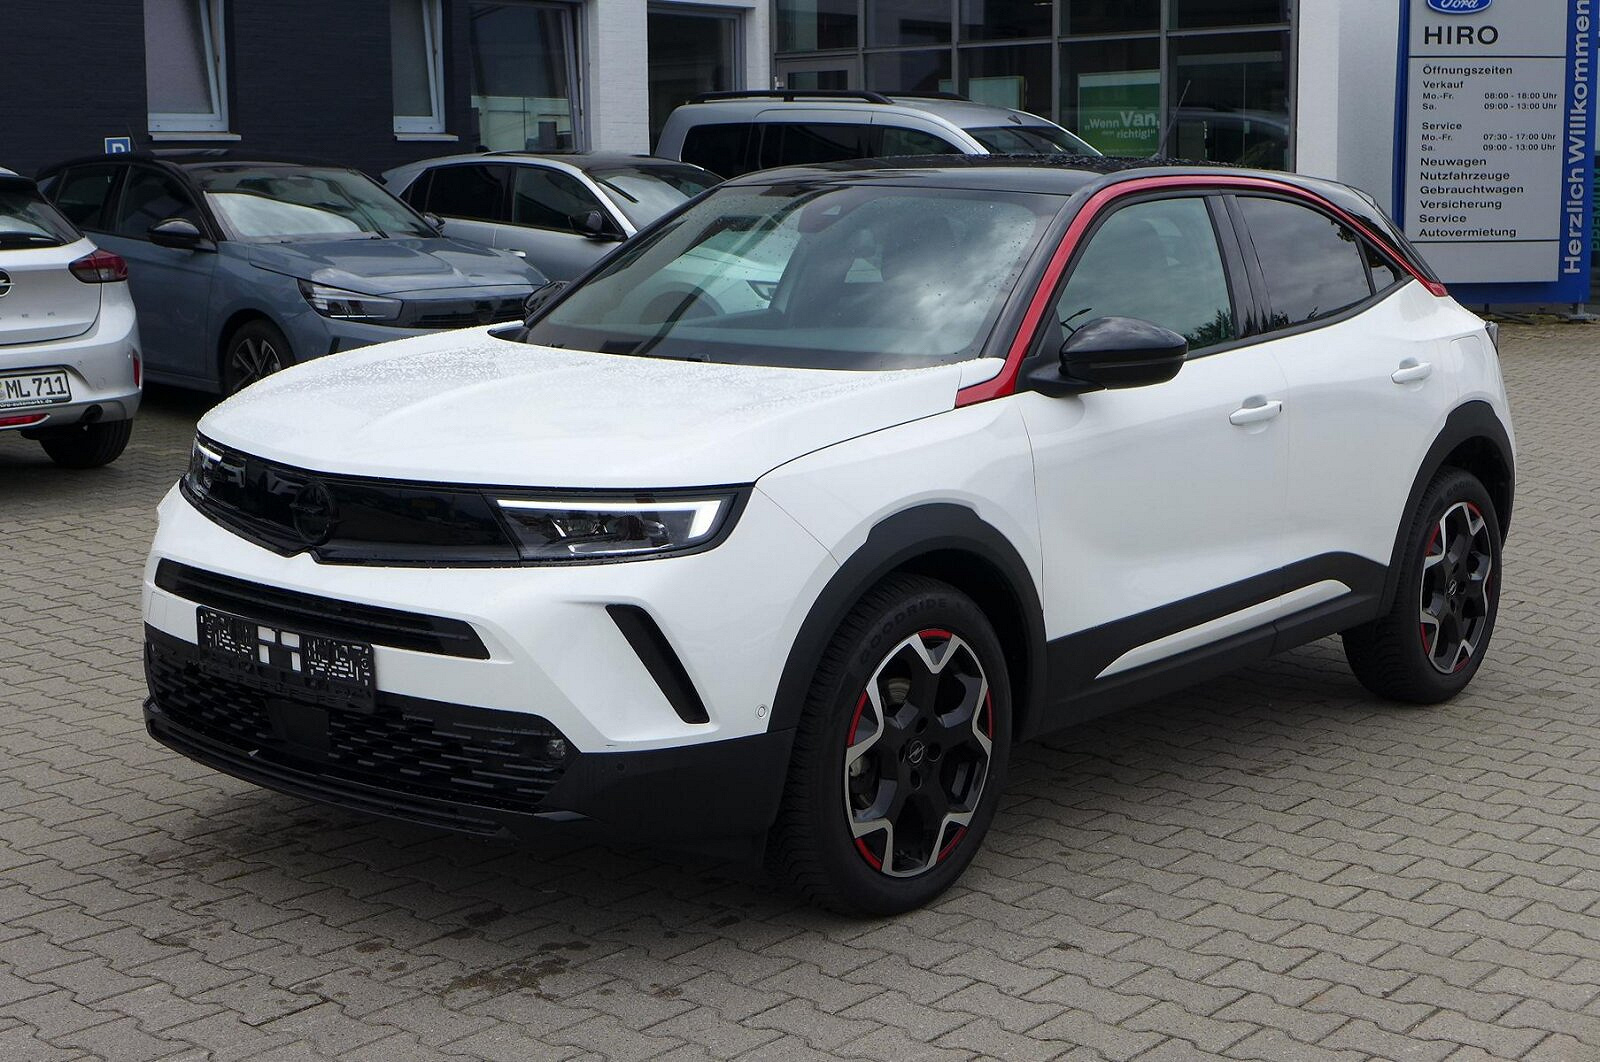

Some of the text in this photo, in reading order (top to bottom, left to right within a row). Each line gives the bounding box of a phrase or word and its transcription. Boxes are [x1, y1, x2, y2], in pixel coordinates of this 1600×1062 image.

[1423, 25, 1499, 45] HIRO
[1422, 64, 1513, 77] Öffnungszeiten
[1422, 80, 1464, 89] Verkauf
[1422, 92, 1454, 100] Mo.-Fr.
[1484, 92, 1509, 100] 08:00
[1517, 92, 1541, 100] 18:00
[1542, 92, 1558, 100] Uhr
[1422, 103, 1437, 111] Sa.
[1542, 102, 1557, 110] Uhr
[1421, 122, 1463, 131] Service
[1421, 133, 1453, 142] Mo.-Fr.
[1483, 133, 1508, 141] 07:30
[1516, 133, 1539, 141] 17:00
[1564, 0, 1590, 274] Herzlich Willkommen
[1421, 144, 1436, 152] Sa.
[1482, 143, 1508, 151] 09:00
[1516, 143, 1539, 151] 13:00
[1541, 143, 1556, 151] Uhr
[1420, 158, 1487, 167] Neuwagen
[1420, 171, 1510, 181] Nutzfahrzeuge
[1420, 185, 1524, 196] Gebrauchtwagen
[1419, 200, 1503, 210] Versicherung
[1419, 214, 1467, 224] Service
[1419, 228, 1517, 238] Autovermietung
[5, 376, 67, 399] ML 711
